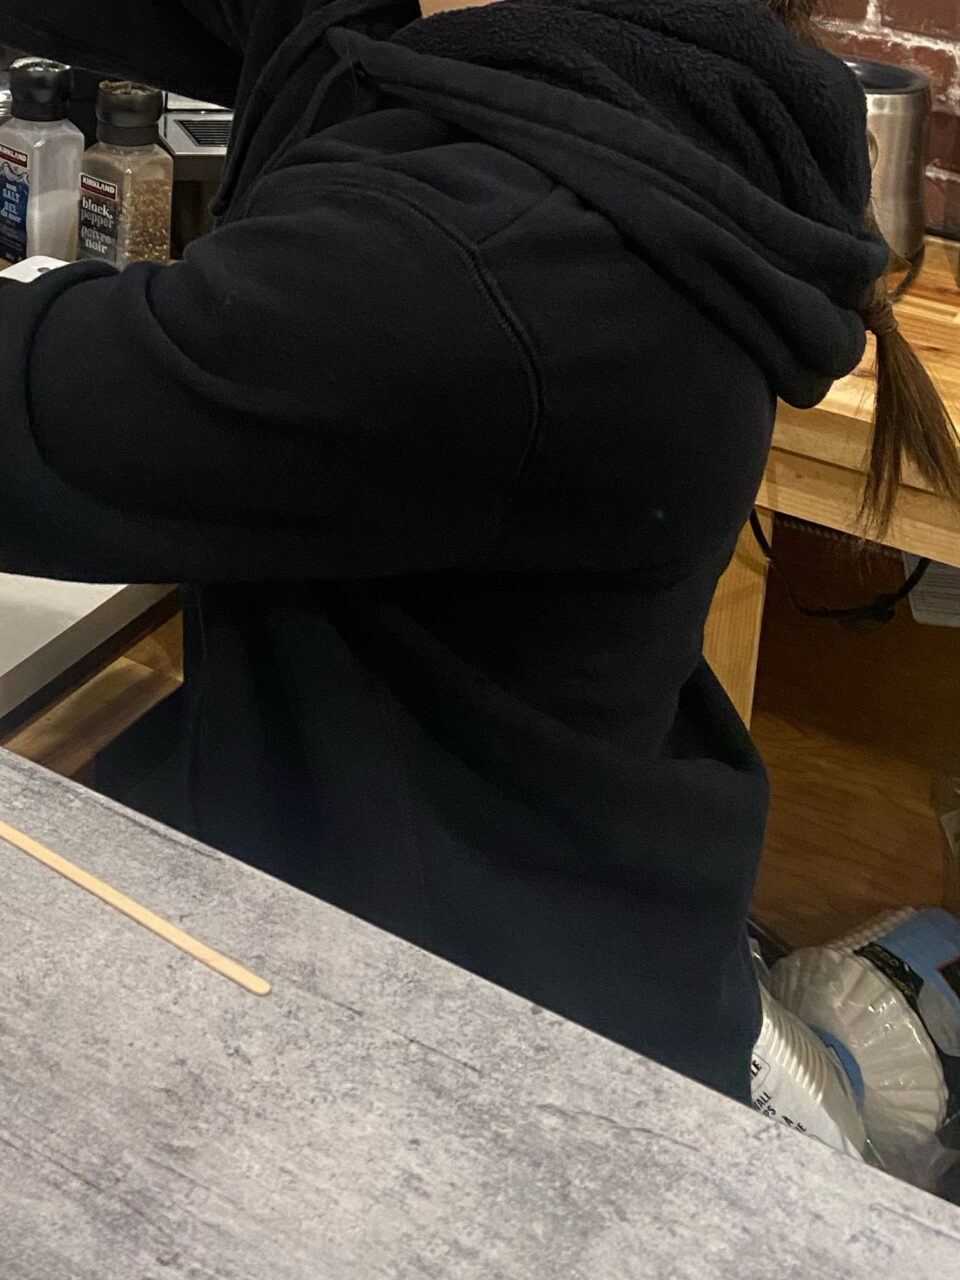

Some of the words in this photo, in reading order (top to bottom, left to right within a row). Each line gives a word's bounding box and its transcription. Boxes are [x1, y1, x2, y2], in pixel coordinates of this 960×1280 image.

[82, 176, 115, 194] KIRKLAND
[3, 188, 19, 203] SALT
[81, 209, 114, 228] pepper
[85, 238, 108, 254] noir
